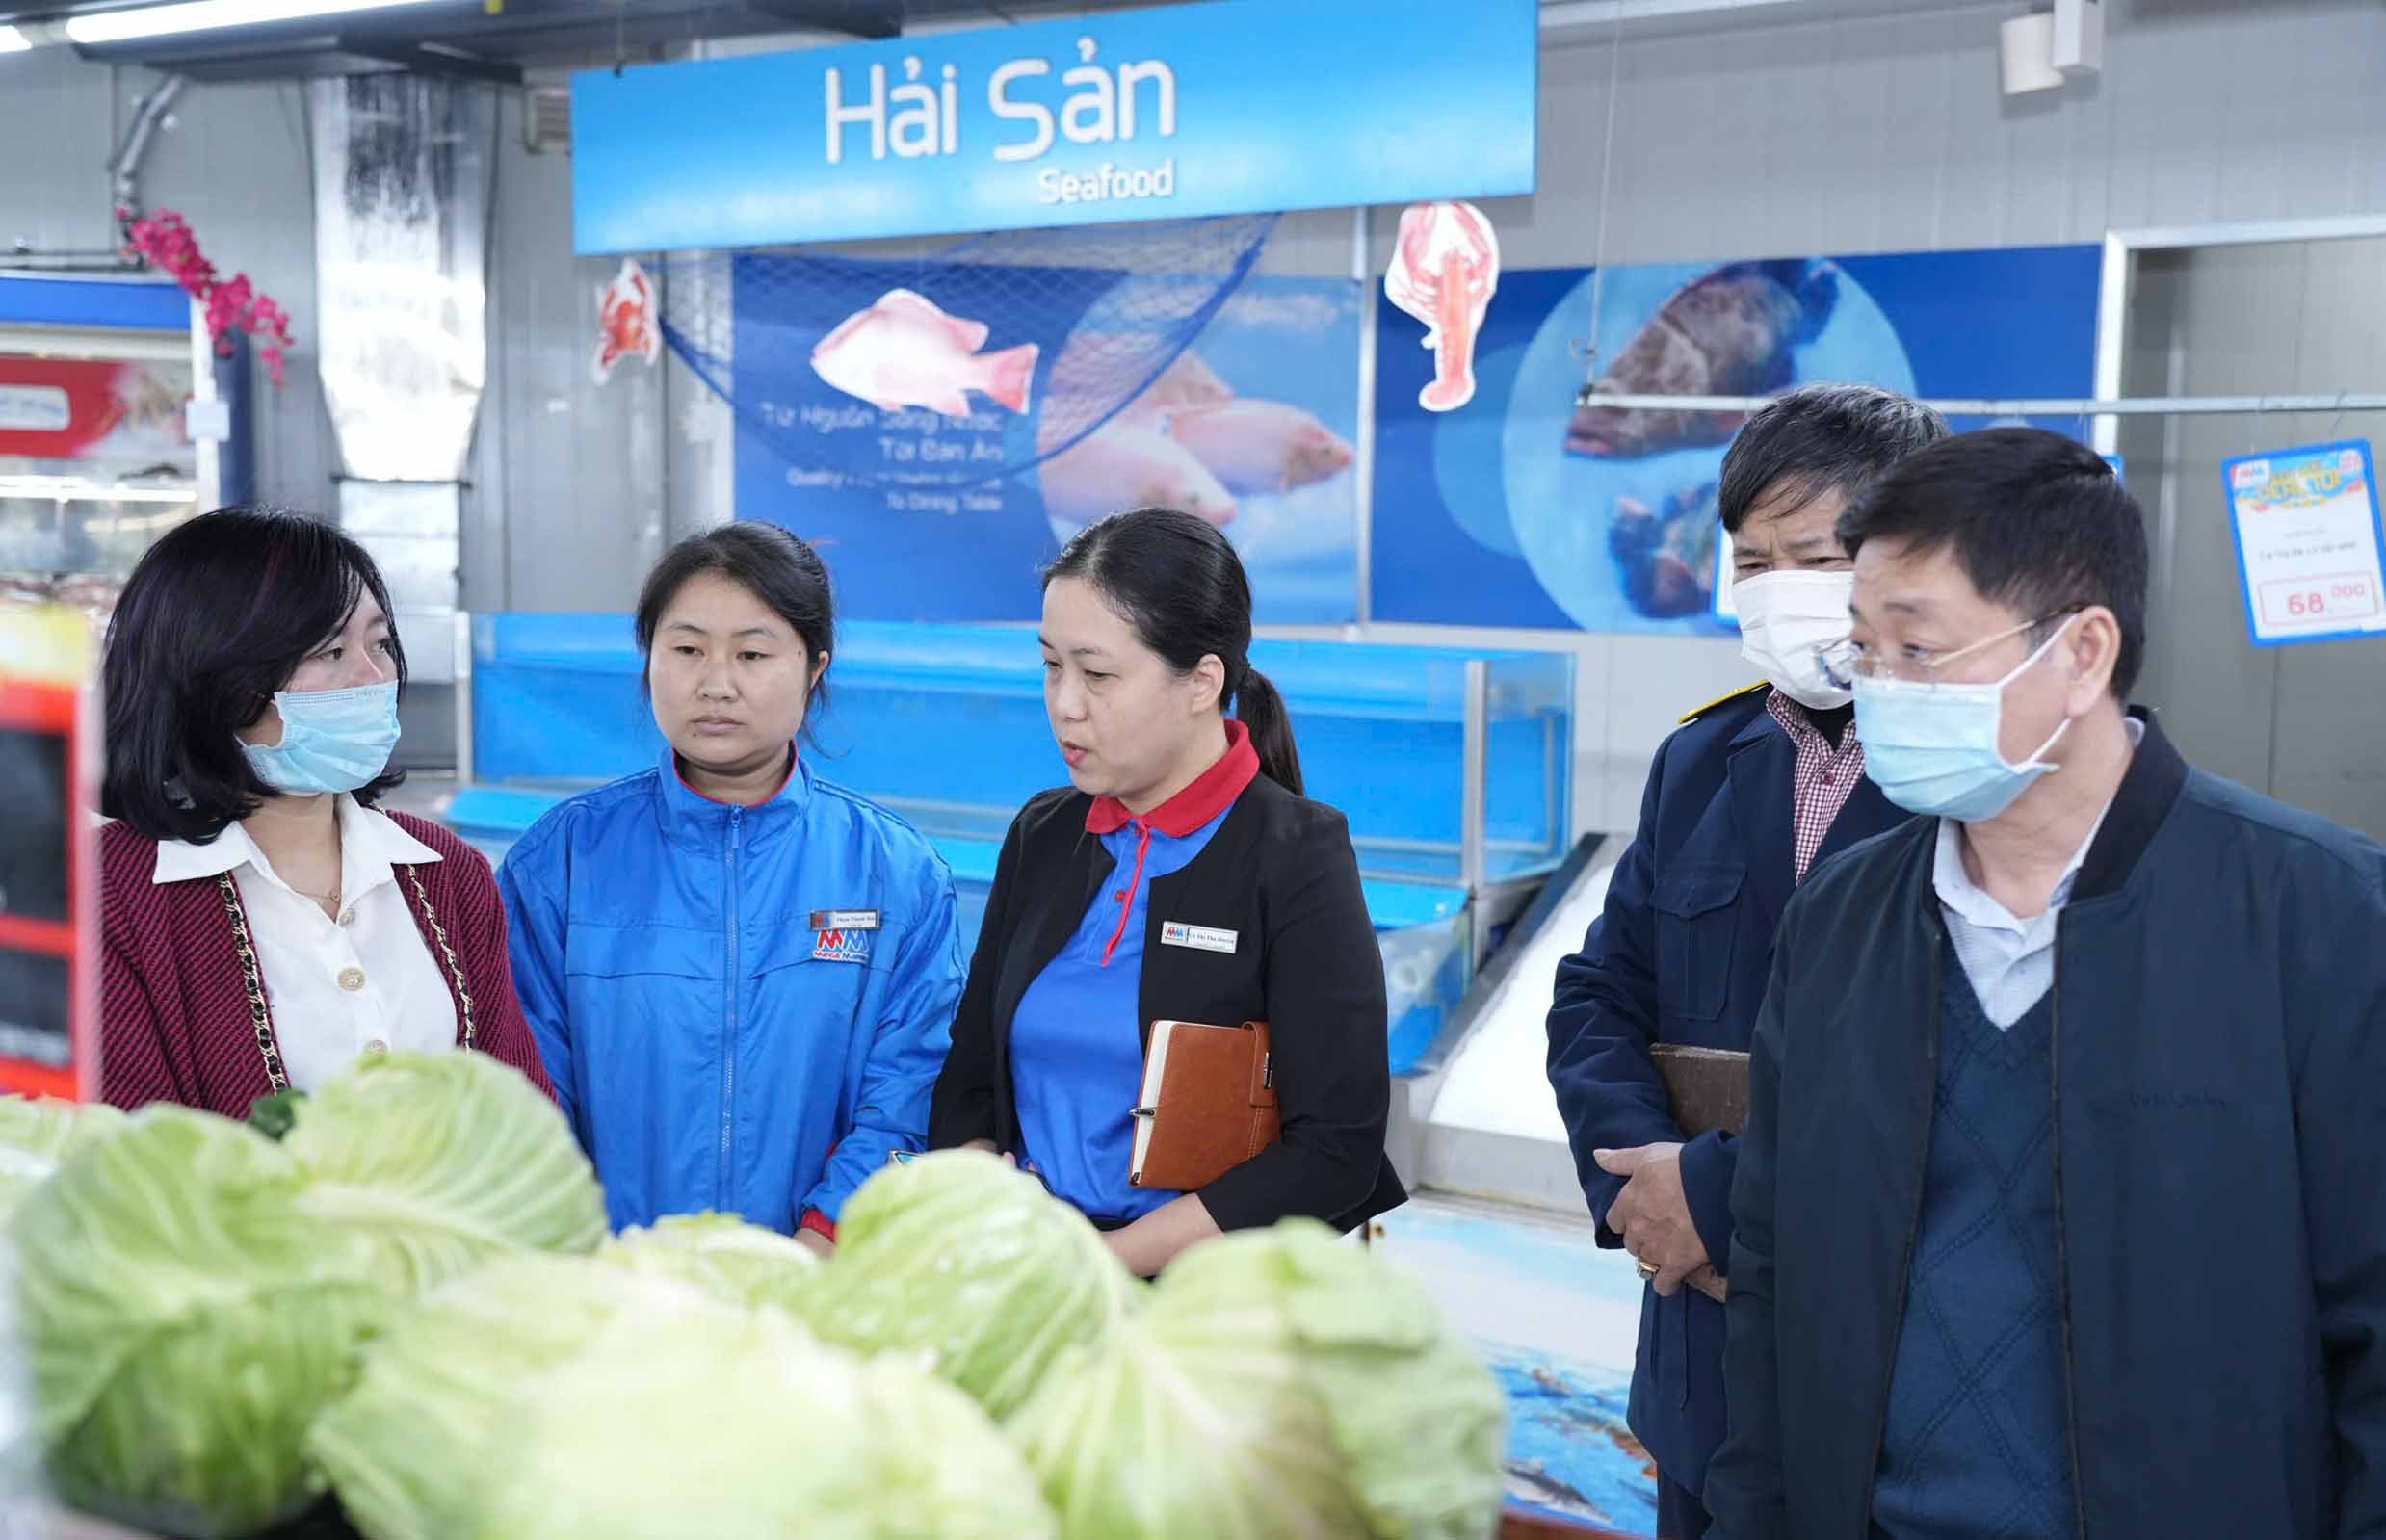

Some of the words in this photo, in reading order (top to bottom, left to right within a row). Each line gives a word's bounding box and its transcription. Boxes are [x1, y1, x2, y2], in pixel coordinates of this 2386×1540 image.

[826, 55, 957, 164] Hải
[987, 36, 1176, 162] Sản
[1037, 159, 1175, 204] Seafood
